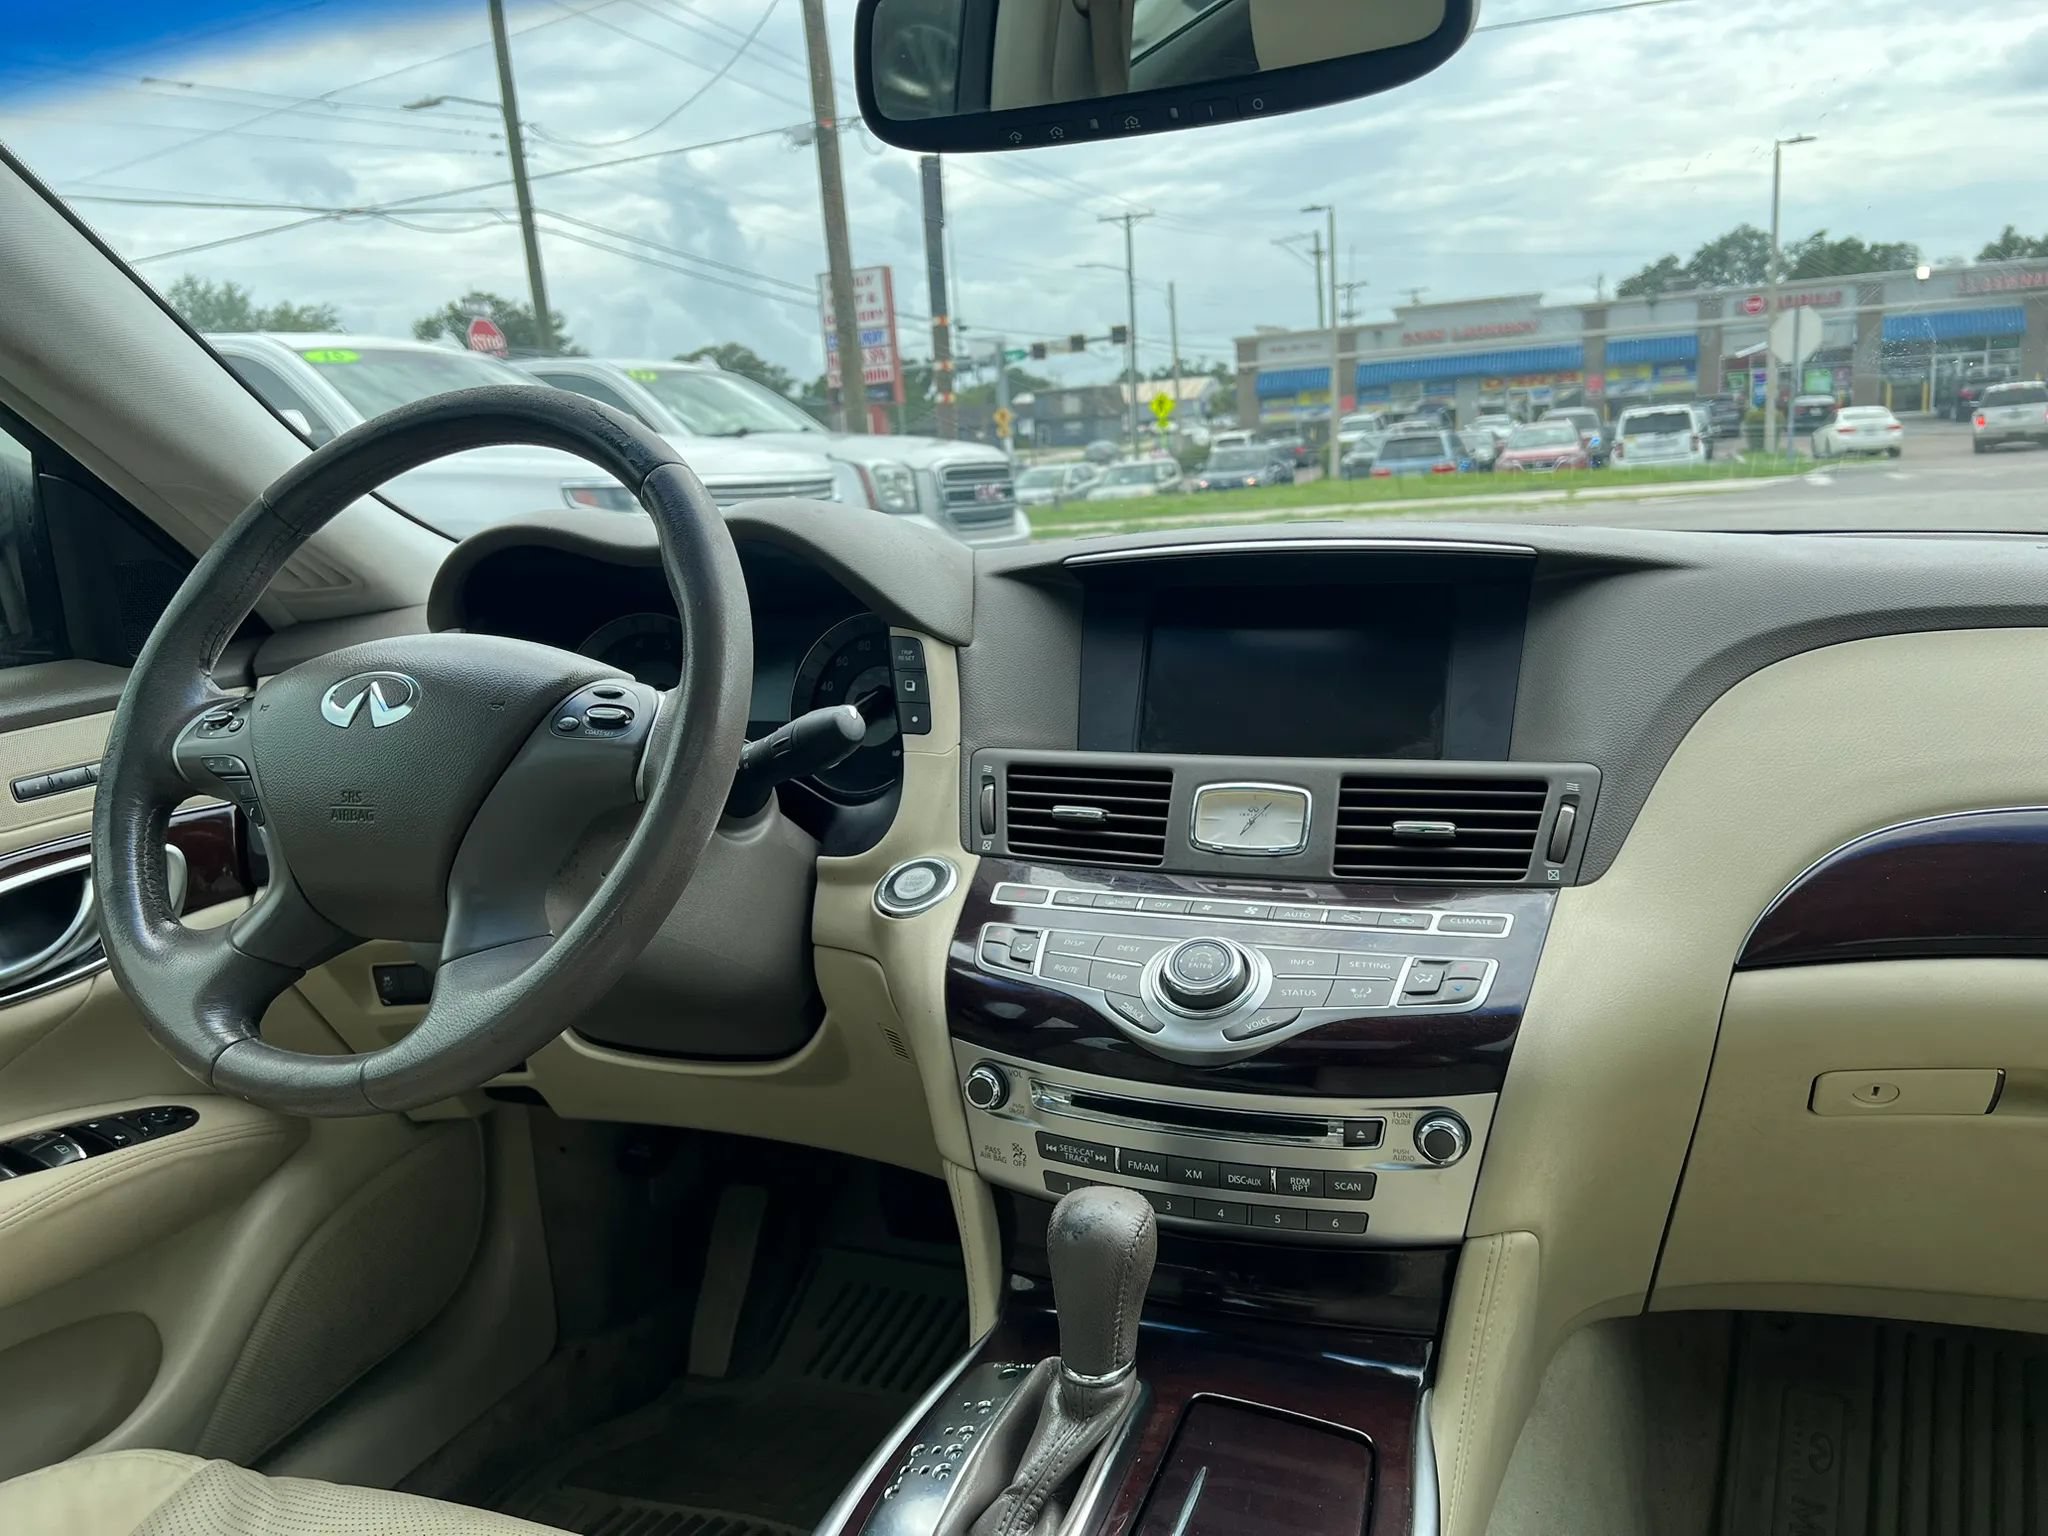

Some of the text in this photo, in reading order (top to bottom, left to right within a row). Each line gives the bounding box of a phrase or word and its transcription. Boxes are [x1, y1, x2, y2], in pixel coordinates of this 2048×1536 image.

[836, 656, 849, 667] 60
[821, 681, 834, 691] 40
[341, 790, 362, 803] SRS
[331, 808, 374, 822] AIRBAG
[1284, 911, 1311, 919] AUTO
[1449, 917, 1493, 925] CLIMATE
[1116, 944, 1140, 953] DEST
[1053, 963, 1080, 975] ROUTE
[1349, 960, 1391, 969] SETTING
[1106, 972, 1128, 981] MAP
[1281, 988, 1317, 997] STATUS
[1126, 1005, 1145, 1021] BACK
[1246, 1015, 1273, 1031] VOICE
[1008, 1069, 1023, 1079] VOL
[1392, 1111, 1413, 1119] TUNE
[984, 1145, 1001, 1155] PASS
[993, 1153, 1007, 1164] BAG
[1064, 1153, 1089, 1164] TRACK
[1013, 1159, 1027, 1168] OFF
[1185, 1169, 1203, 1180] XM
[1290, 1177, 1311, 1186] RDM
[1066, 1183, 1070, 1191] 1
[1292, 1184, 1309, 1192] RPT
[1334, 1182, 1362, 1191] SCAN
[1166, 1200, 1172, 1210] 3
[1217, 1208, 1224, 1218] 4
[1274, 1214, 1281, 1223] 5
[1332, 1219, 1339, 1228] 6
